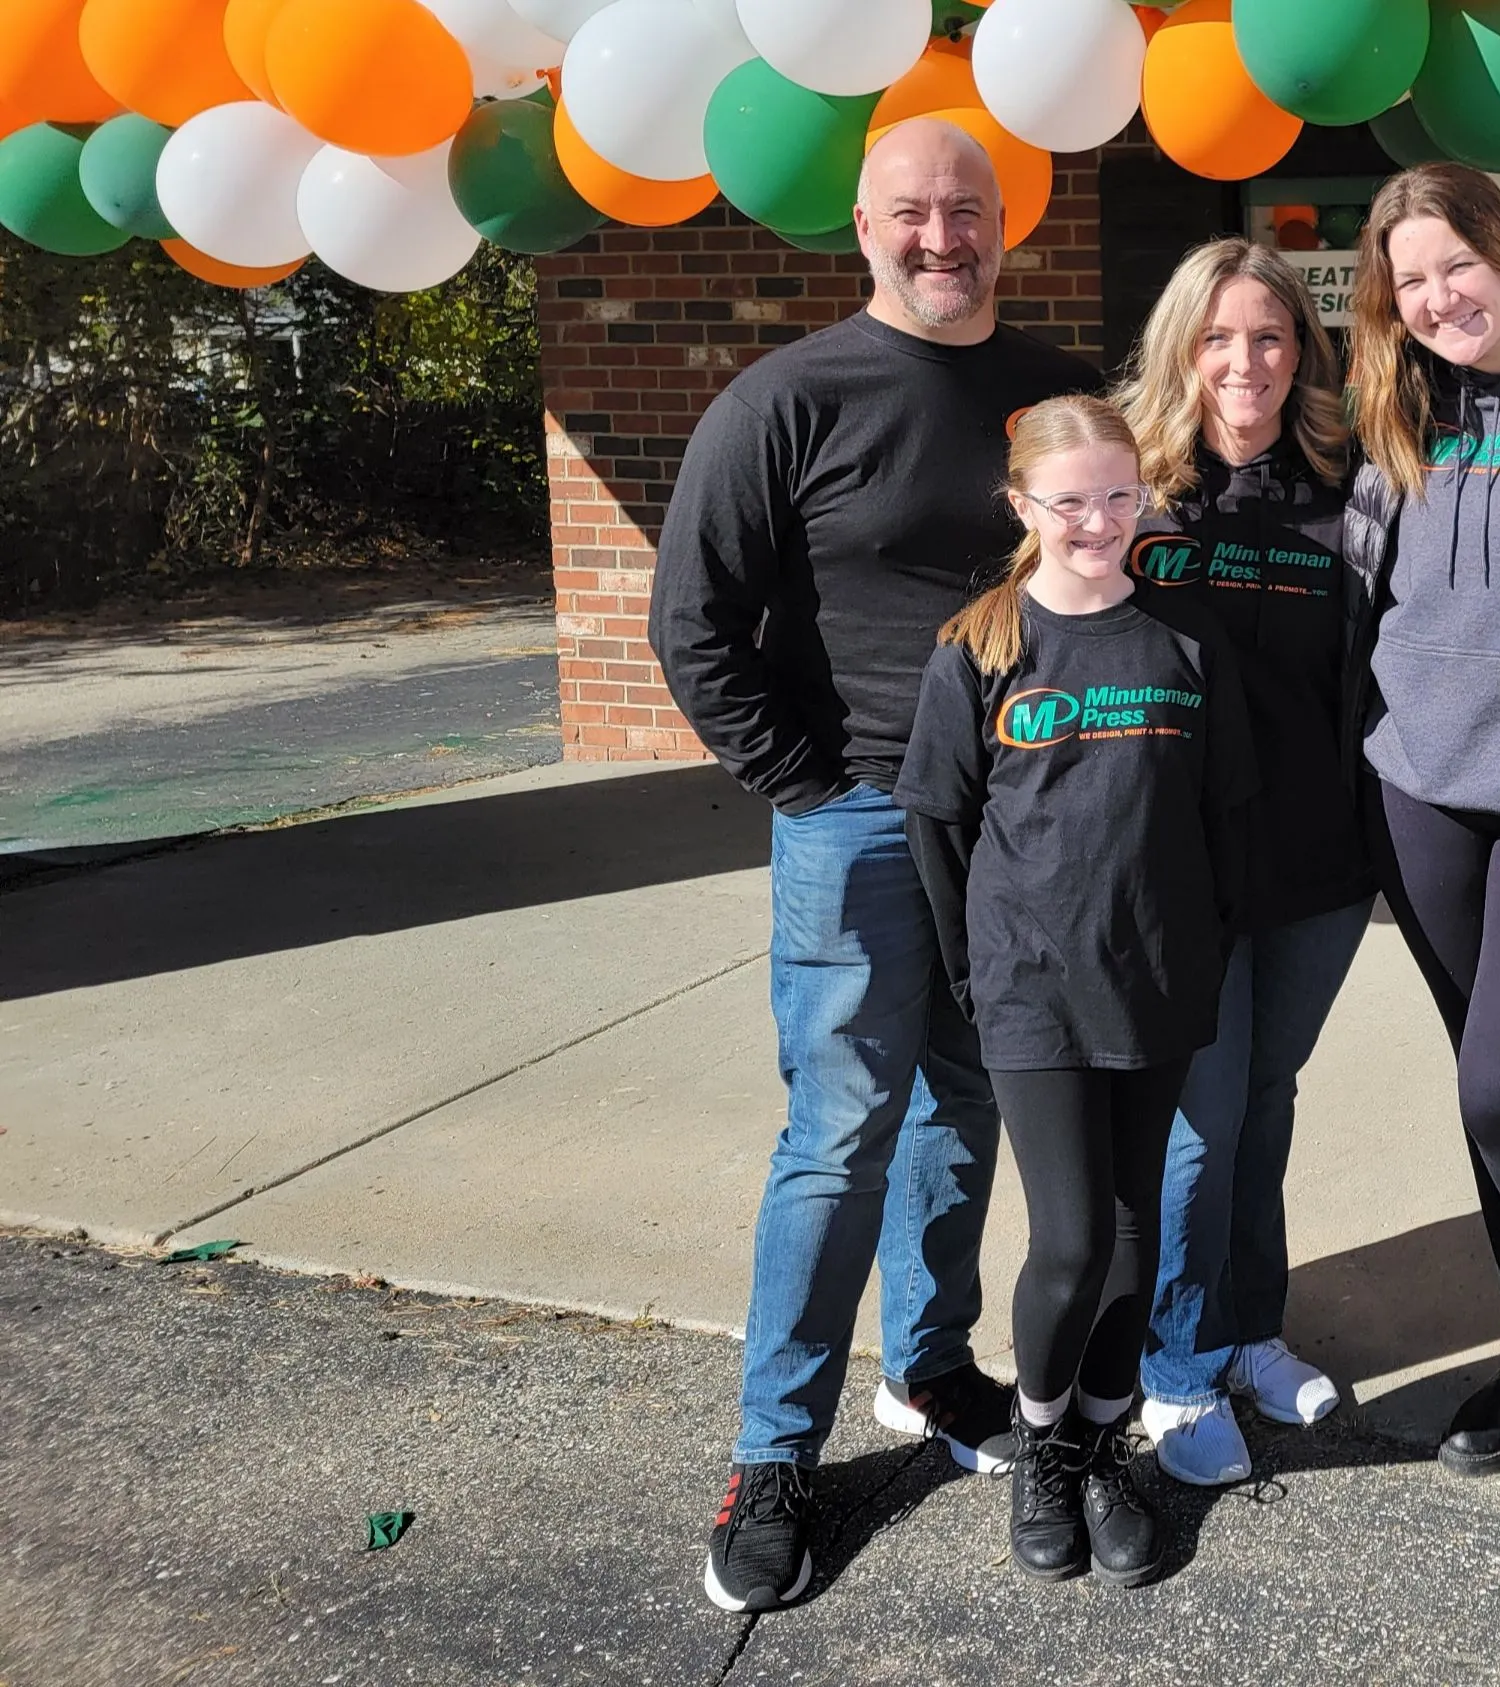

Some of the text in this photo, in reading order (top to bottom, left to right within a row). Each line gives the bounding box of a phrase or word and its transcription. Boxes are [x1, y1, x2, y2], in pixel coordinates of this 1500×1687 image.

[1300, 266, 1355, 286] EAT
[1084, 685, 1203, 709] Minuteman
[1011, 693, 1080, 743] MP
[1079, 732, 1090, 741] WE
[1124, 727, 1147, 736] PRINT
